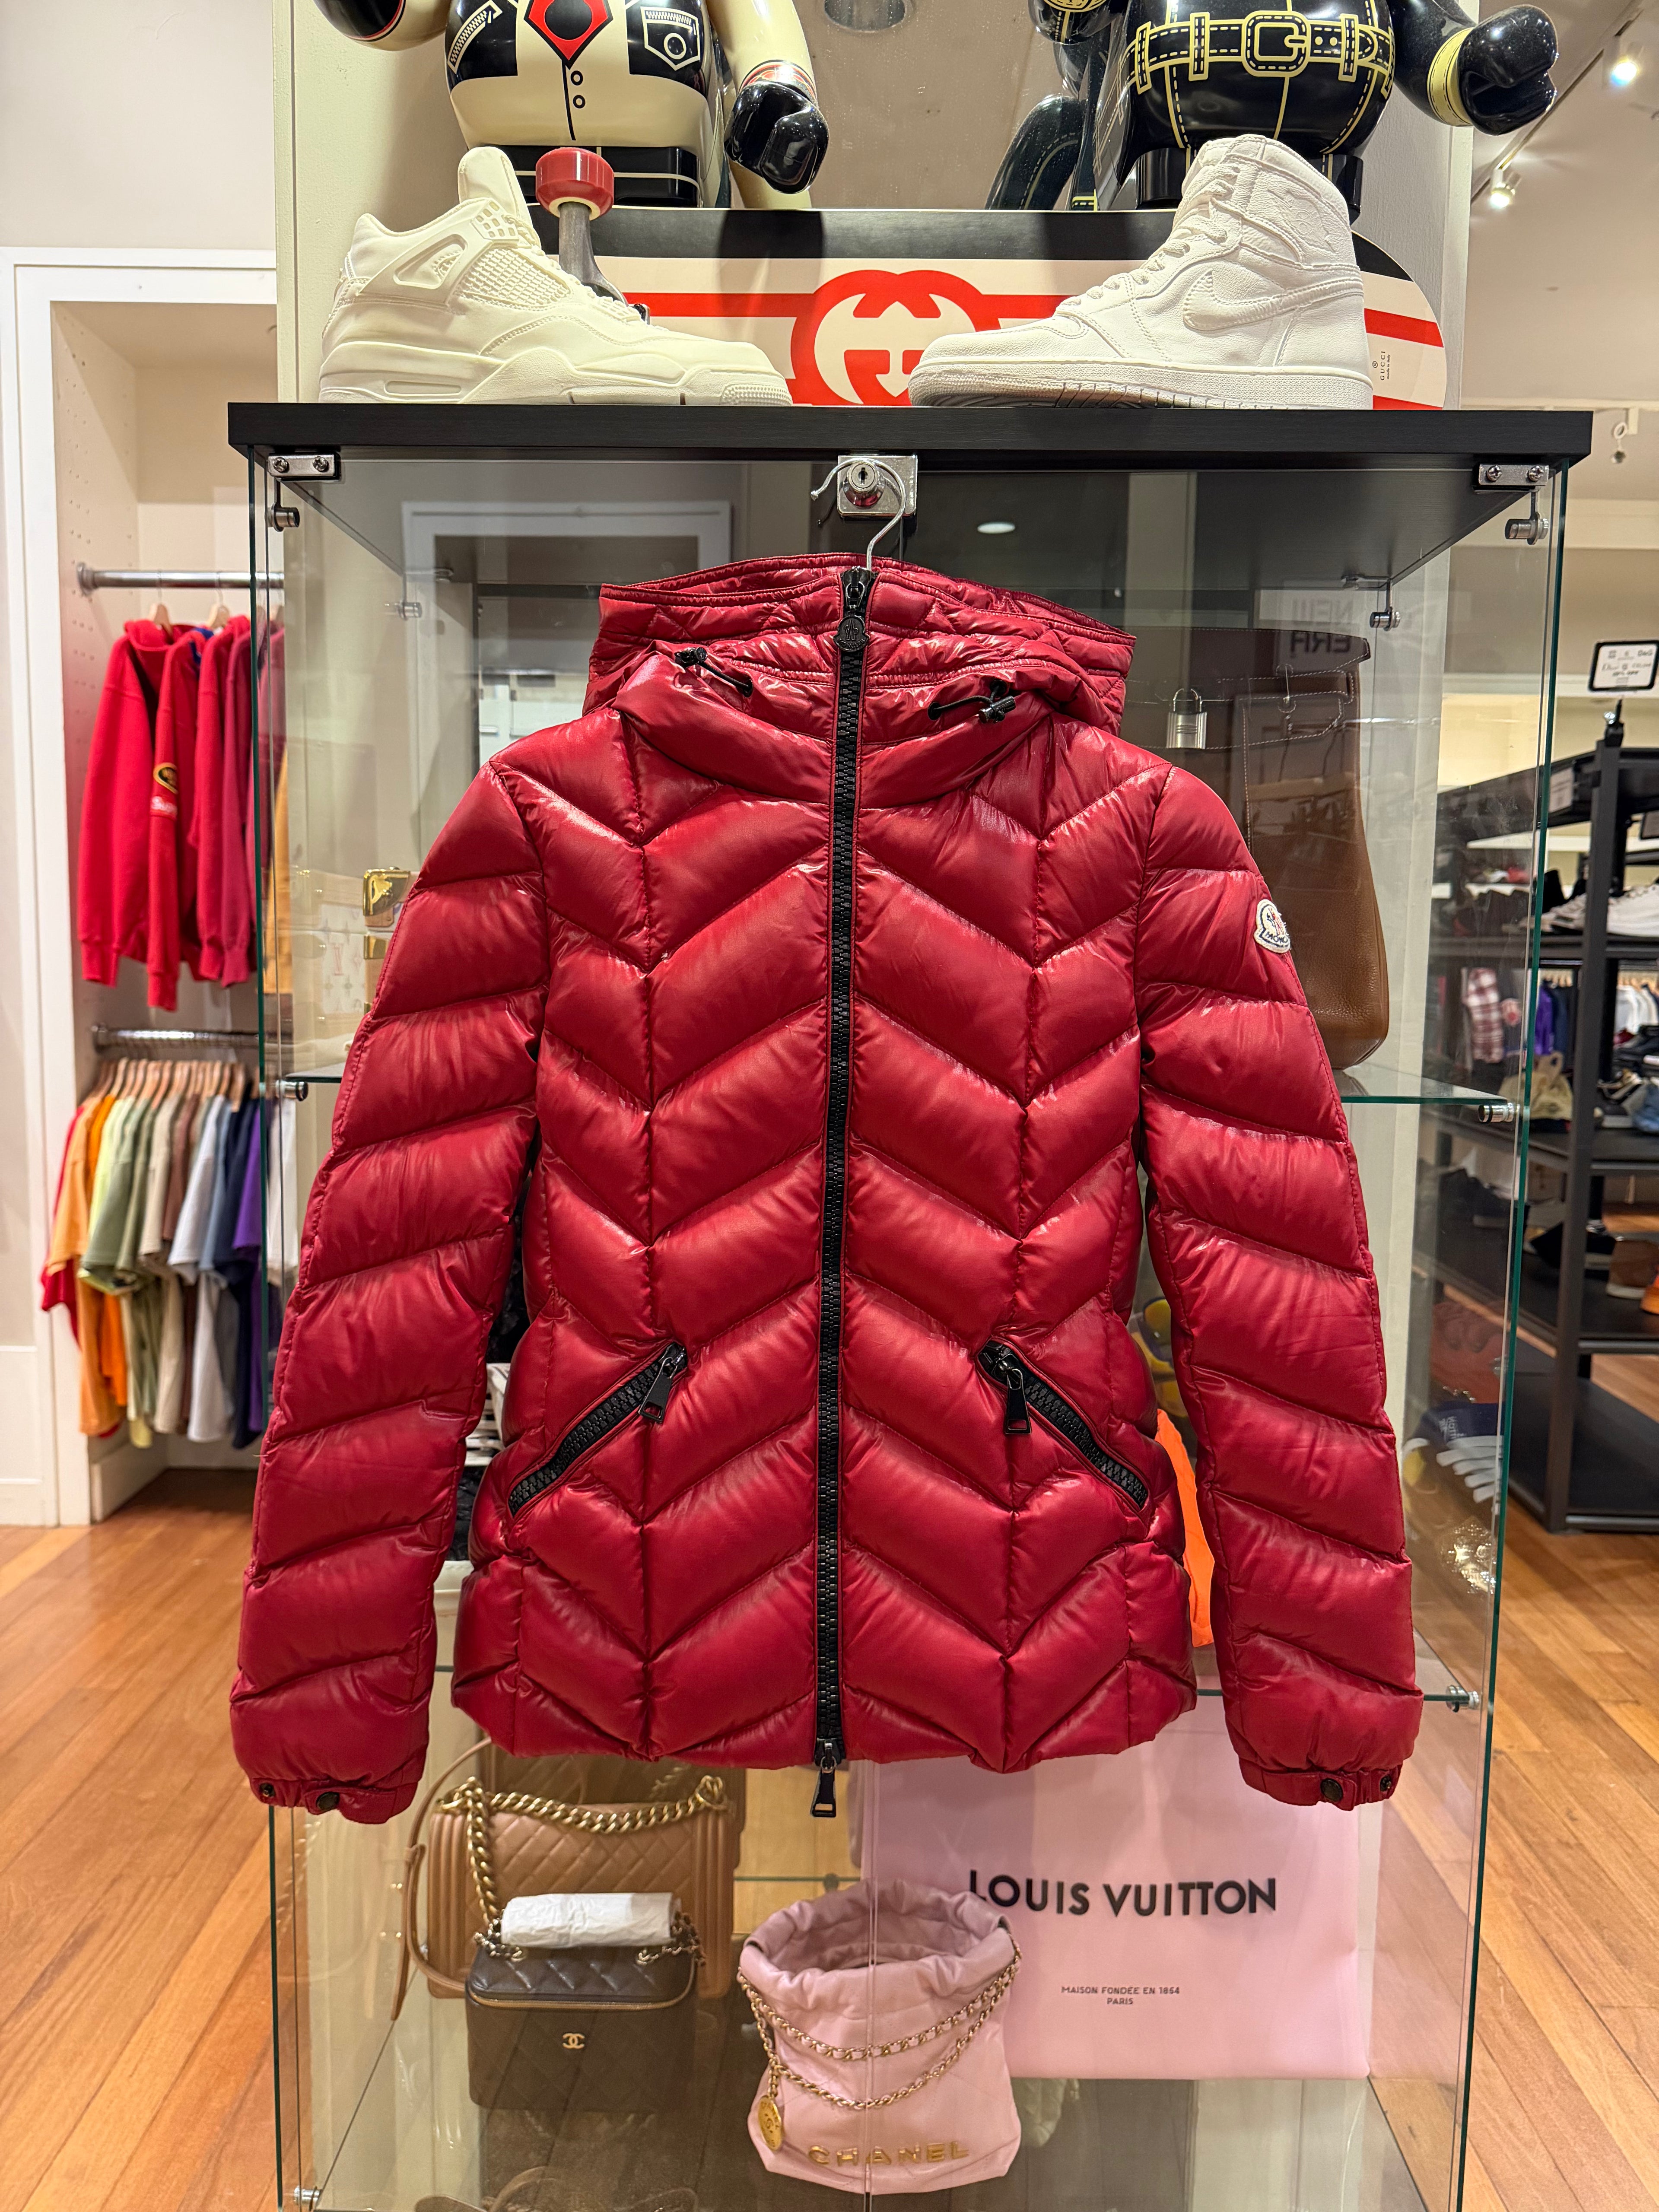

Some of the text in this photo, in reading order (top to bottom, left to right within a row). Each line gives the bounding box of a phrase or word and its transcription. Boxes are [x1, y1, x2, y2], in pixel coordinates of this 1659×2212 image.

[969, 1869, 1276, 1917] LOUIS VUITTON
[808, 2140, 969, 2167] CHANEL
